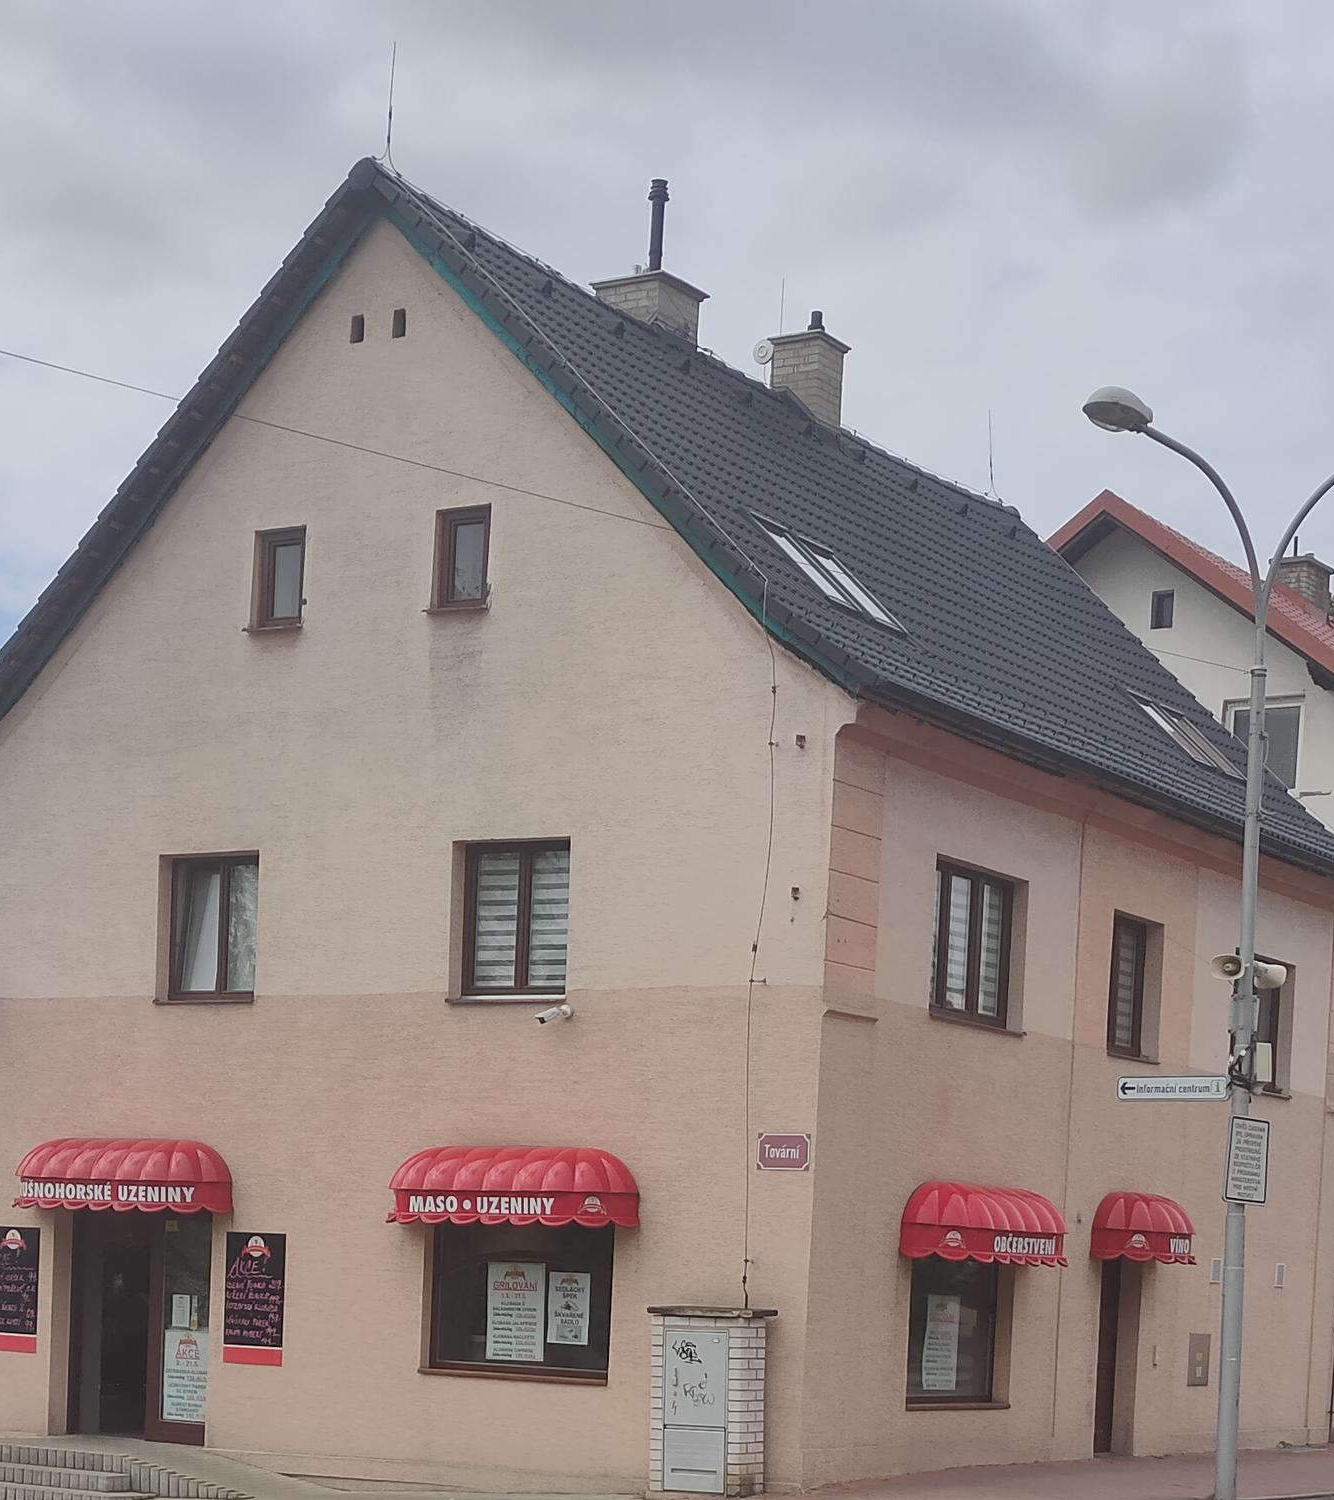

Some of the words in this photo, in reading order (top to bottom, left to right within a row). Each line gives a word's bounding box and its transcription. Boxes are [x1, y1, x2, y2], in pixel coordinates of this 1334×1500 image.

[1136, 1083, 1177, 1093] Informační
[1178, 1084, 1210, 1093] centrum
[763, 1144, 801, 1159] Tovární
[118, 1185, 196, 1202] UZENINY
[409, 1195, 458, 1213] MASO
[476, 1196, 555, 1215] UZENINY
[994, 1233, 1056, 1255] OBČERSTVENÍ
[1170, 1236, 1190, 1254] VÍNO
[176, 1348, 200, 1359] AKCE
